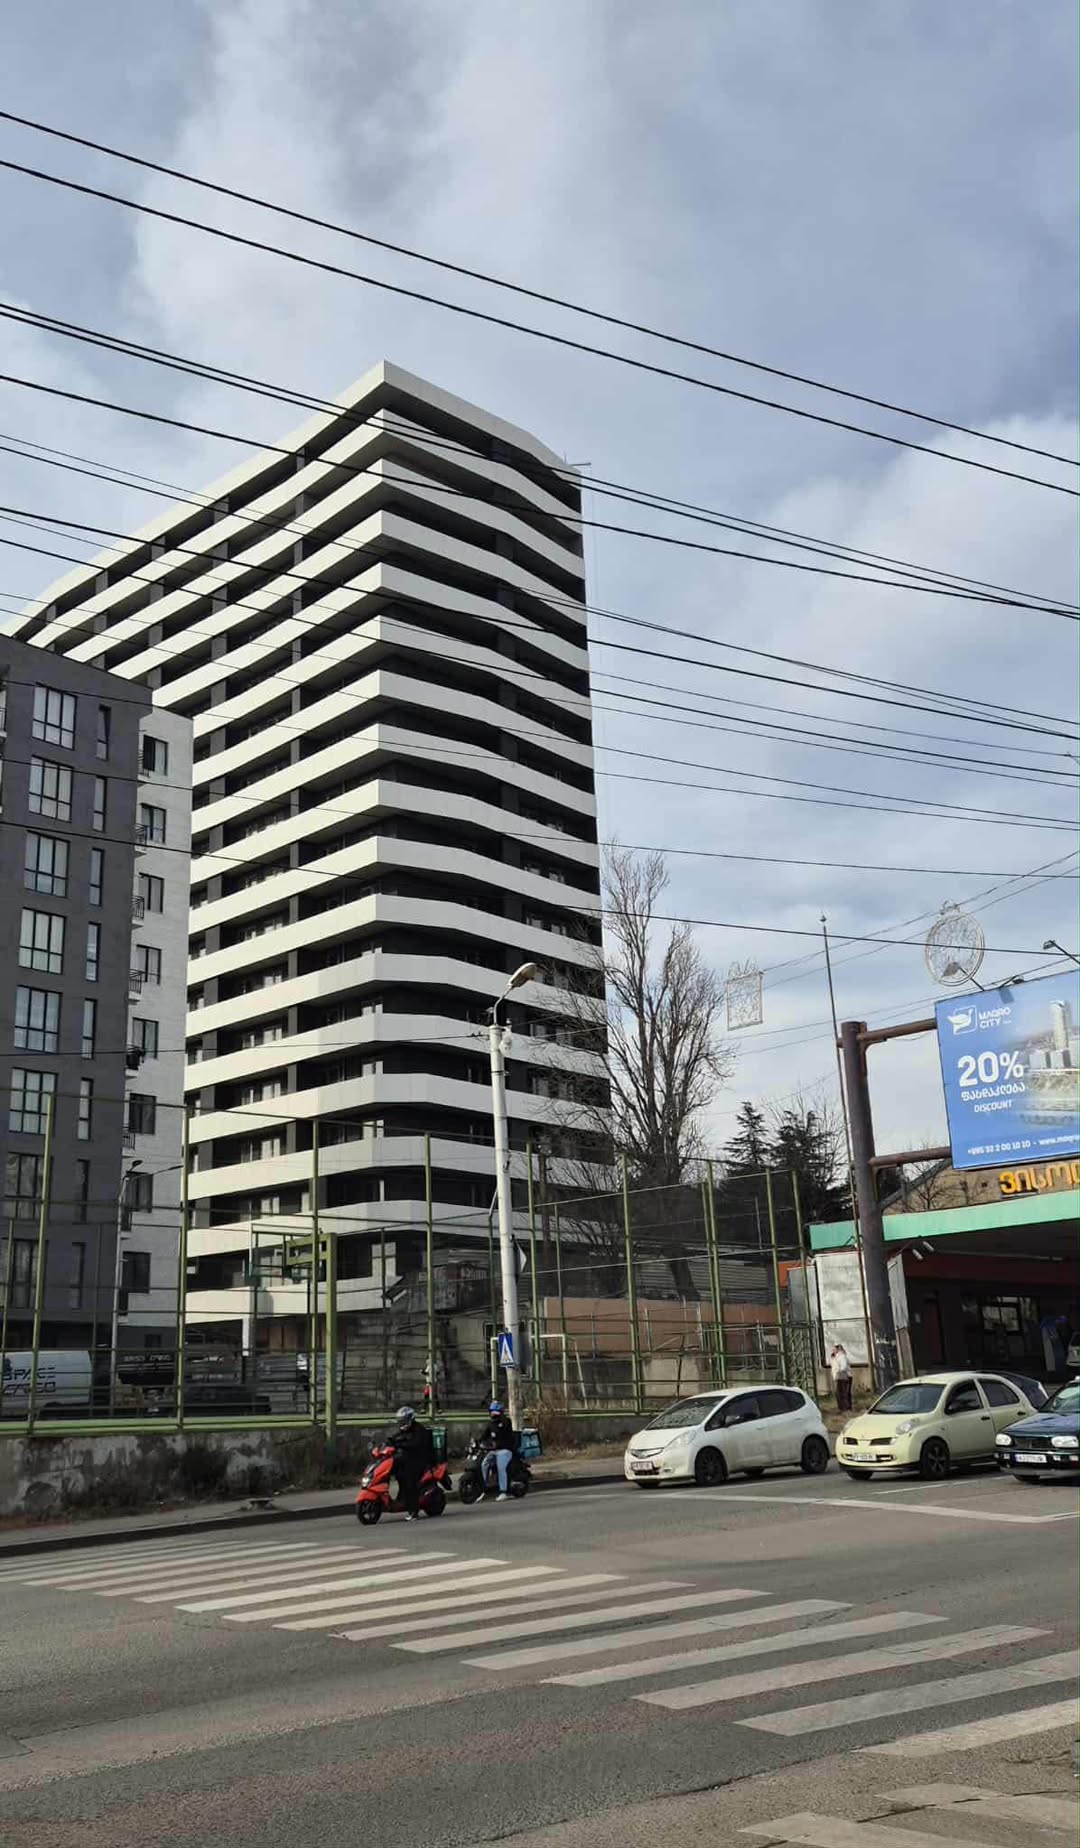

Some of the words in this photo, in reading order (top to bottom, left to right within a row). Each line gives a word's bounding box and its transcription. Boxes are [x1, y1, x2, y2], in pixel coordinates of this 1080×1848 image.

[979, 1018, 1001, 1029] CITY
[958, 1050, 1024, 1087] 20%
[961, 1082, 1026, 1102] ფასდაკლება
[974, 1100, 1013, 1112] DISCOUNT
